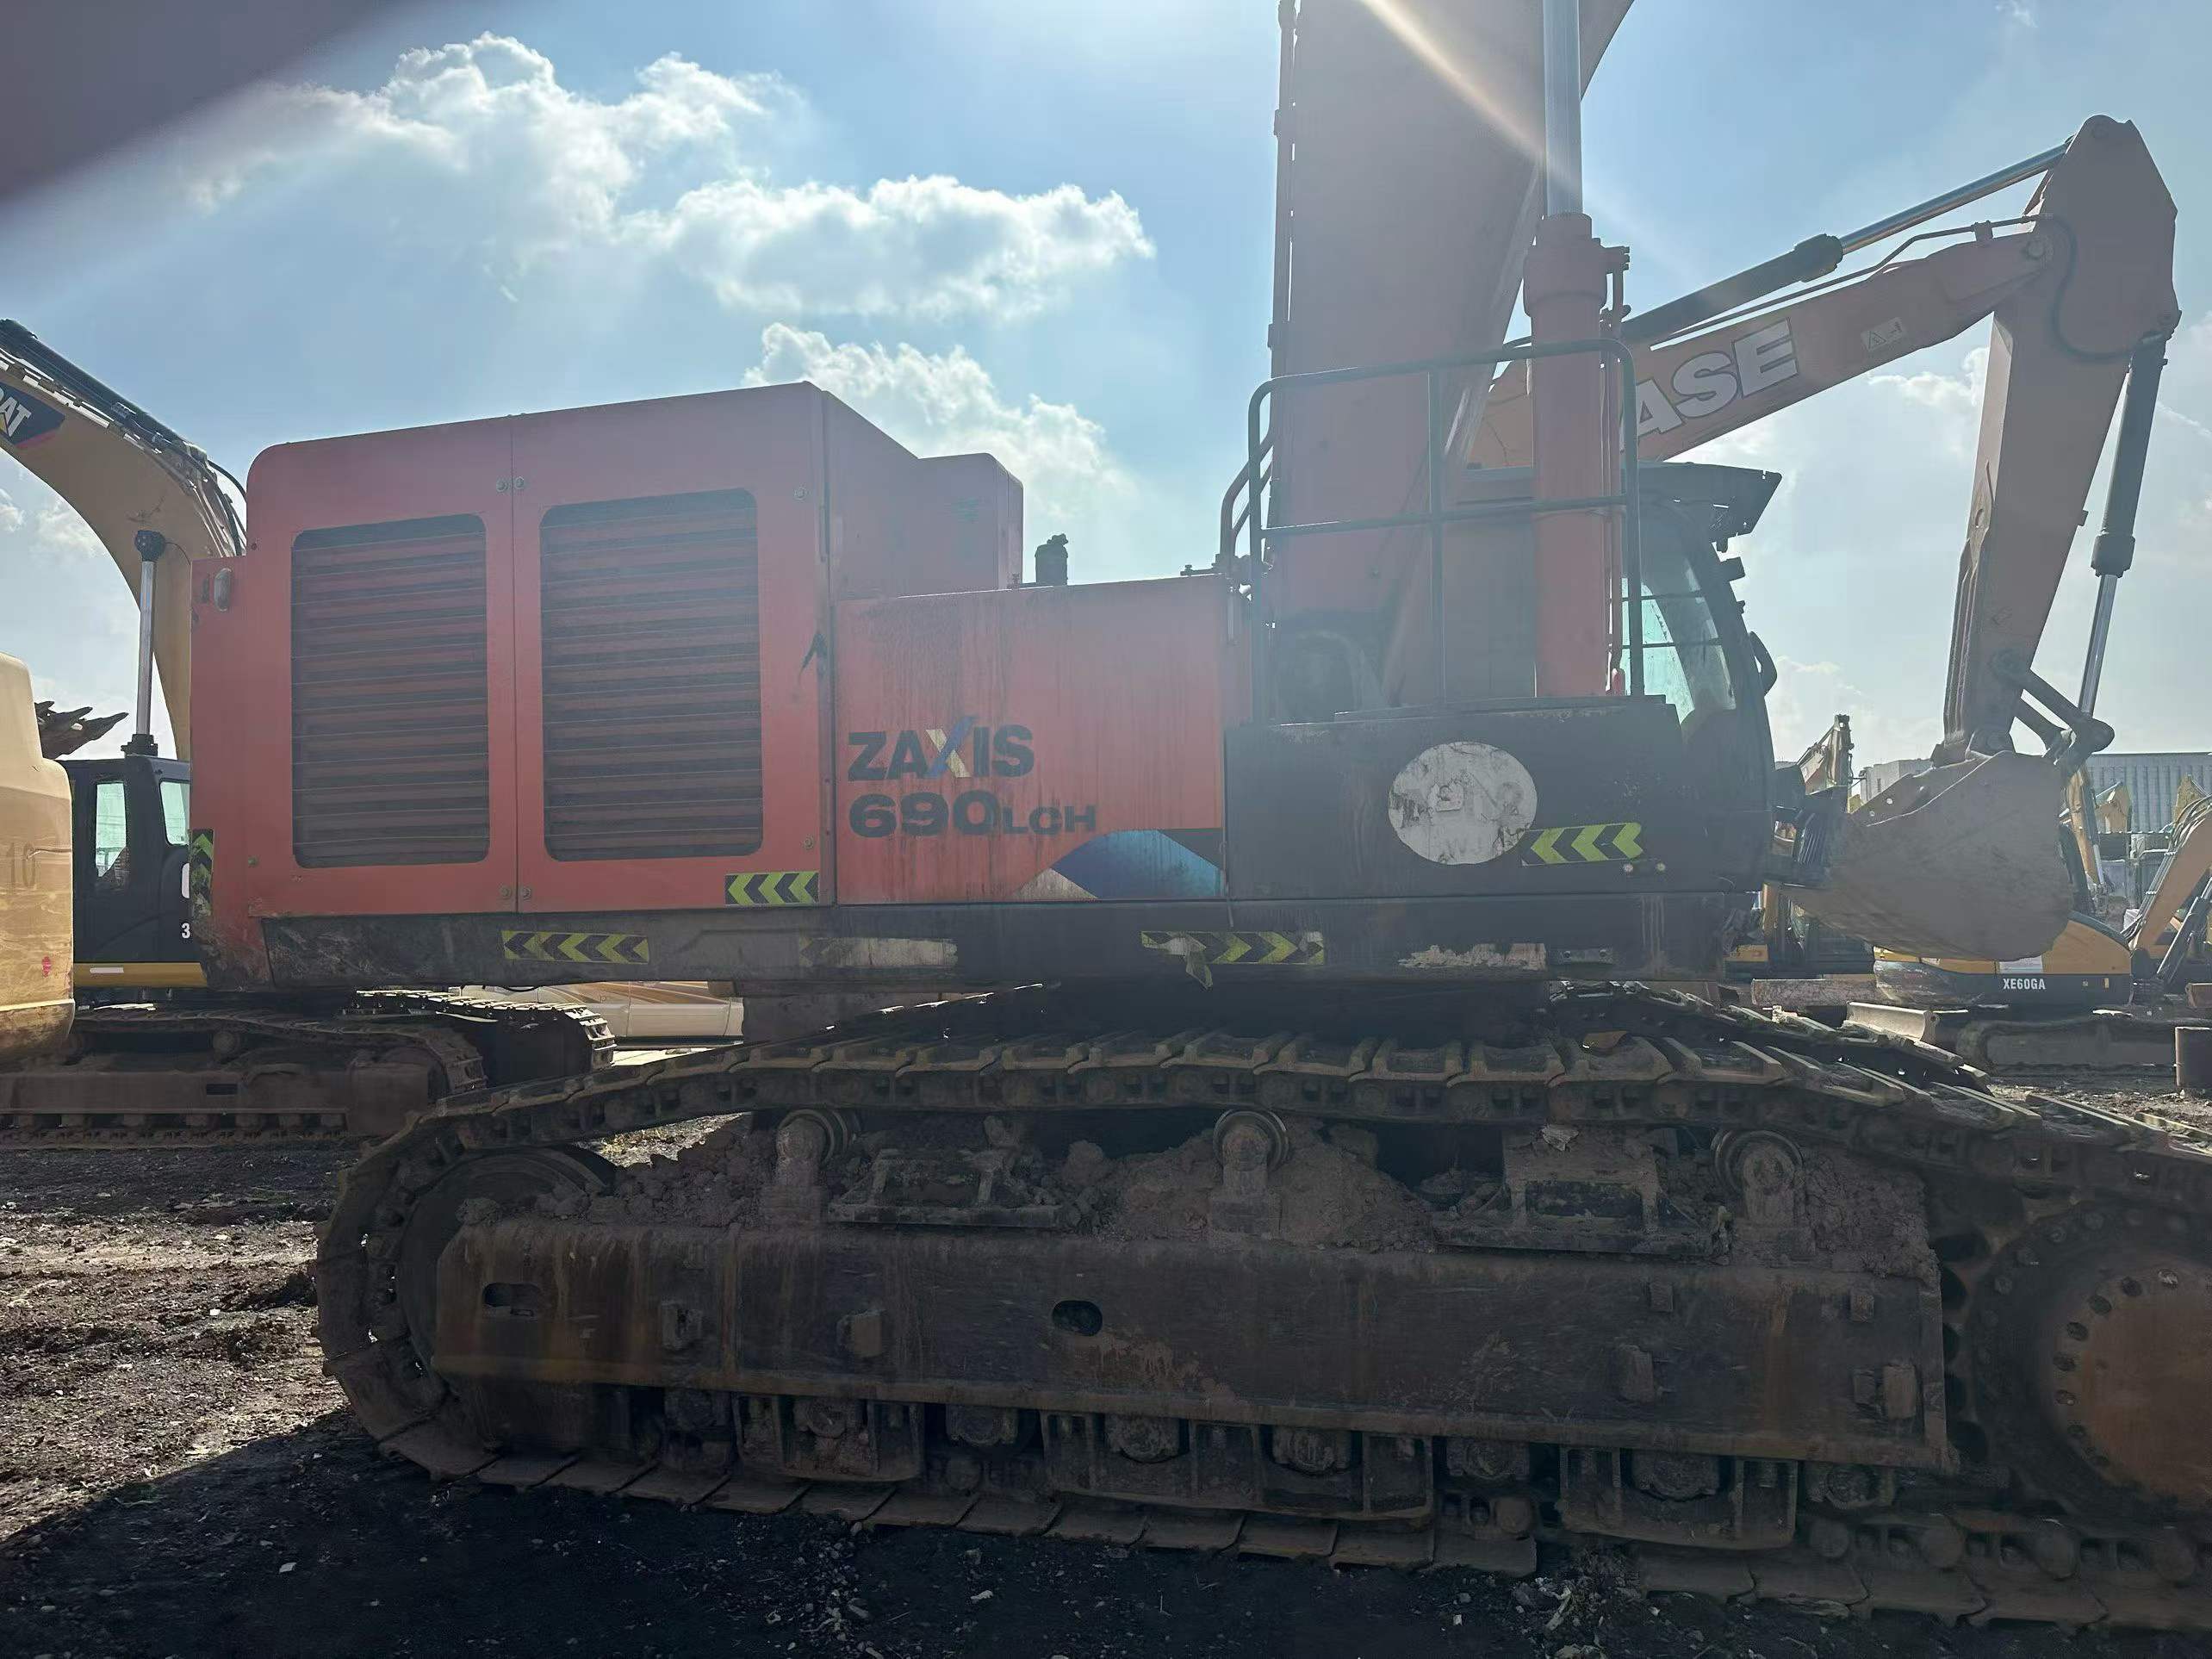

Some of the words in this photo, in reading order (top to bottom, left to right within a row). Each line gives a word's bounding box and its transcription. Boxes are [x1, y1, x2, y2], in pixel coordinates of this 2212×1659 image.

[1635, 318, 1799, 437] ASE
[0, 388, 32, 437] AT
[848, 716, 1034, 781] ZAXIS
[848, 790, 1097, 838] 690LCH
[2003, 978, 2046, 990] XE60GA
